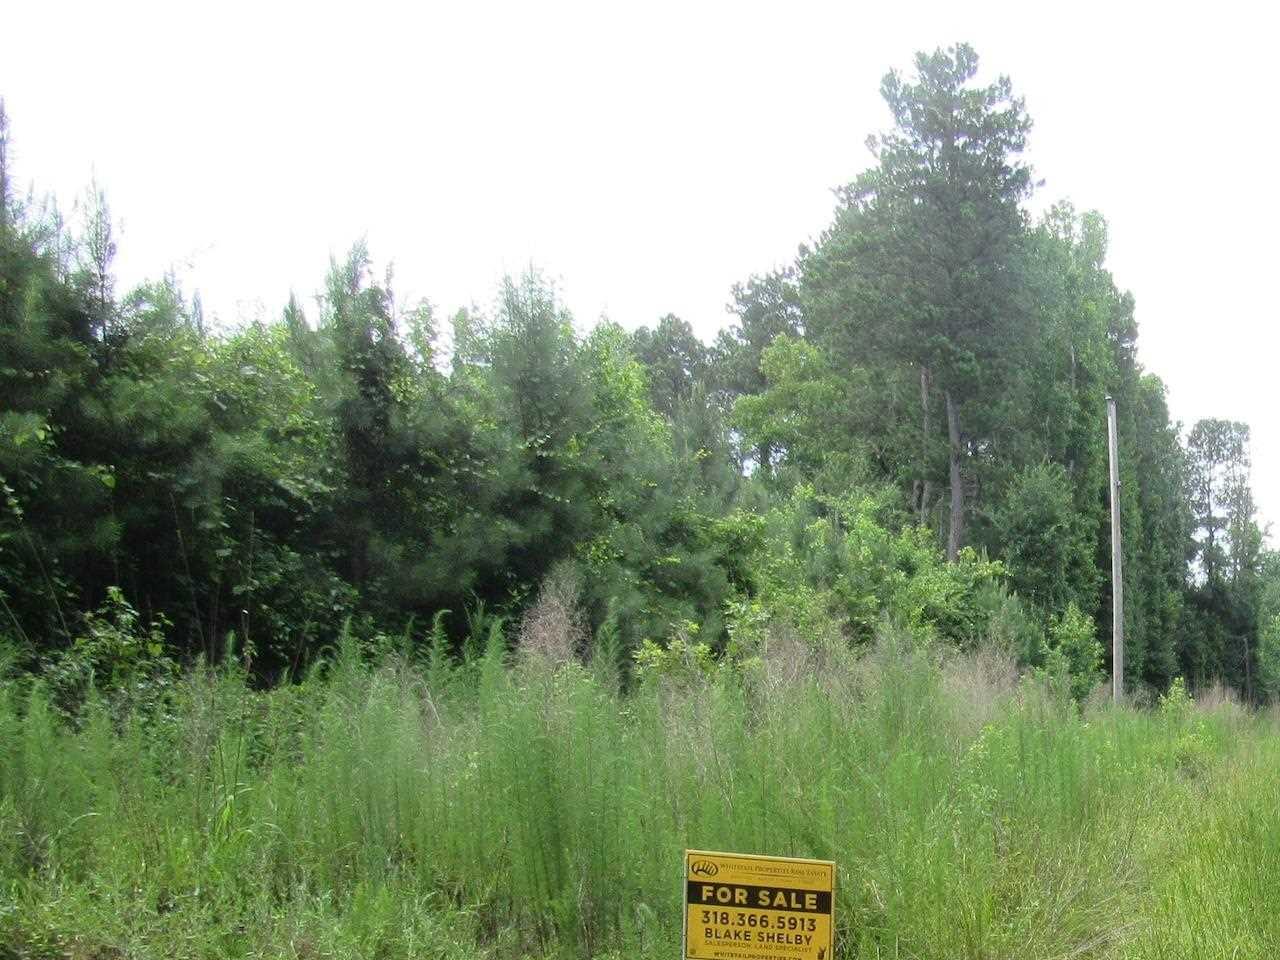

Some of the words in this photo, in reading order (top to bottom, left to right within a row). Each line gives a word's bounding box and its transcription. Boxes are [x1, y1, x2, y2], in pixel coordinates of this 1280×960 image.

[702, 886, 748, 905] FOR
[758, 890, 817, 910] SALE
[702, 910, 817, 932] 318.366.5913
[705, 928, 752, 941] BLAKE
[757, 932, 812, 945] SHELBY
